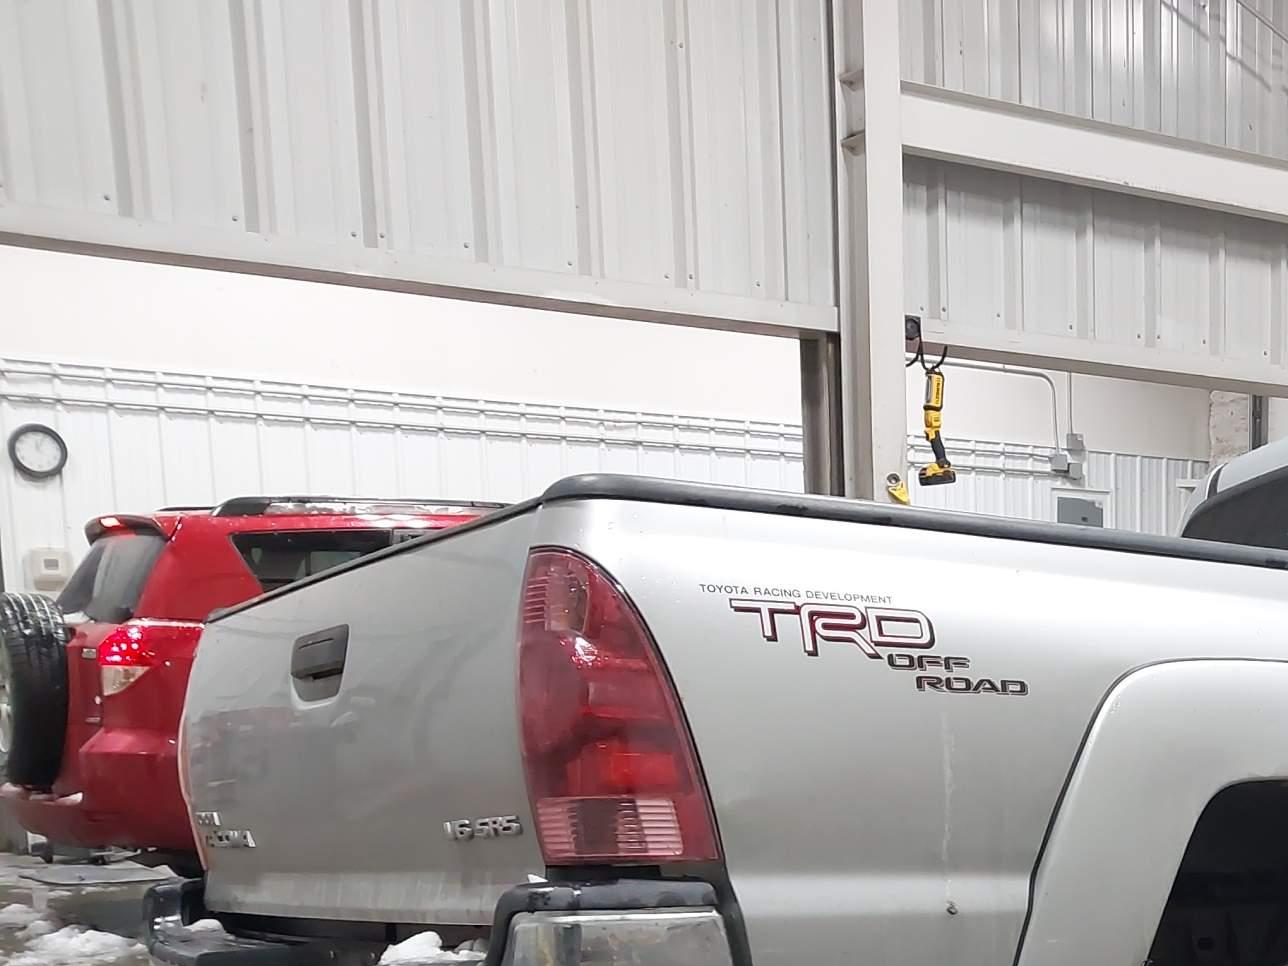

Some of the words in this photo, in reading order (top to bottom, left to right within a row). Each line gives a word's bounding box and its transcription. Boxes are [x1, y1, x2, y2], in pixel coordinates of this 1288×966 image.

[699, 583, 749, 595] TOYOTA
[753, 587, 801, 598] RACING
[806, 590, 893, 604] DEVELOPMENT
[728, 598, 935, 659] TRD
[887, 653, 970, 672] OFF
[915, 675, 1029, 696] ROAD
